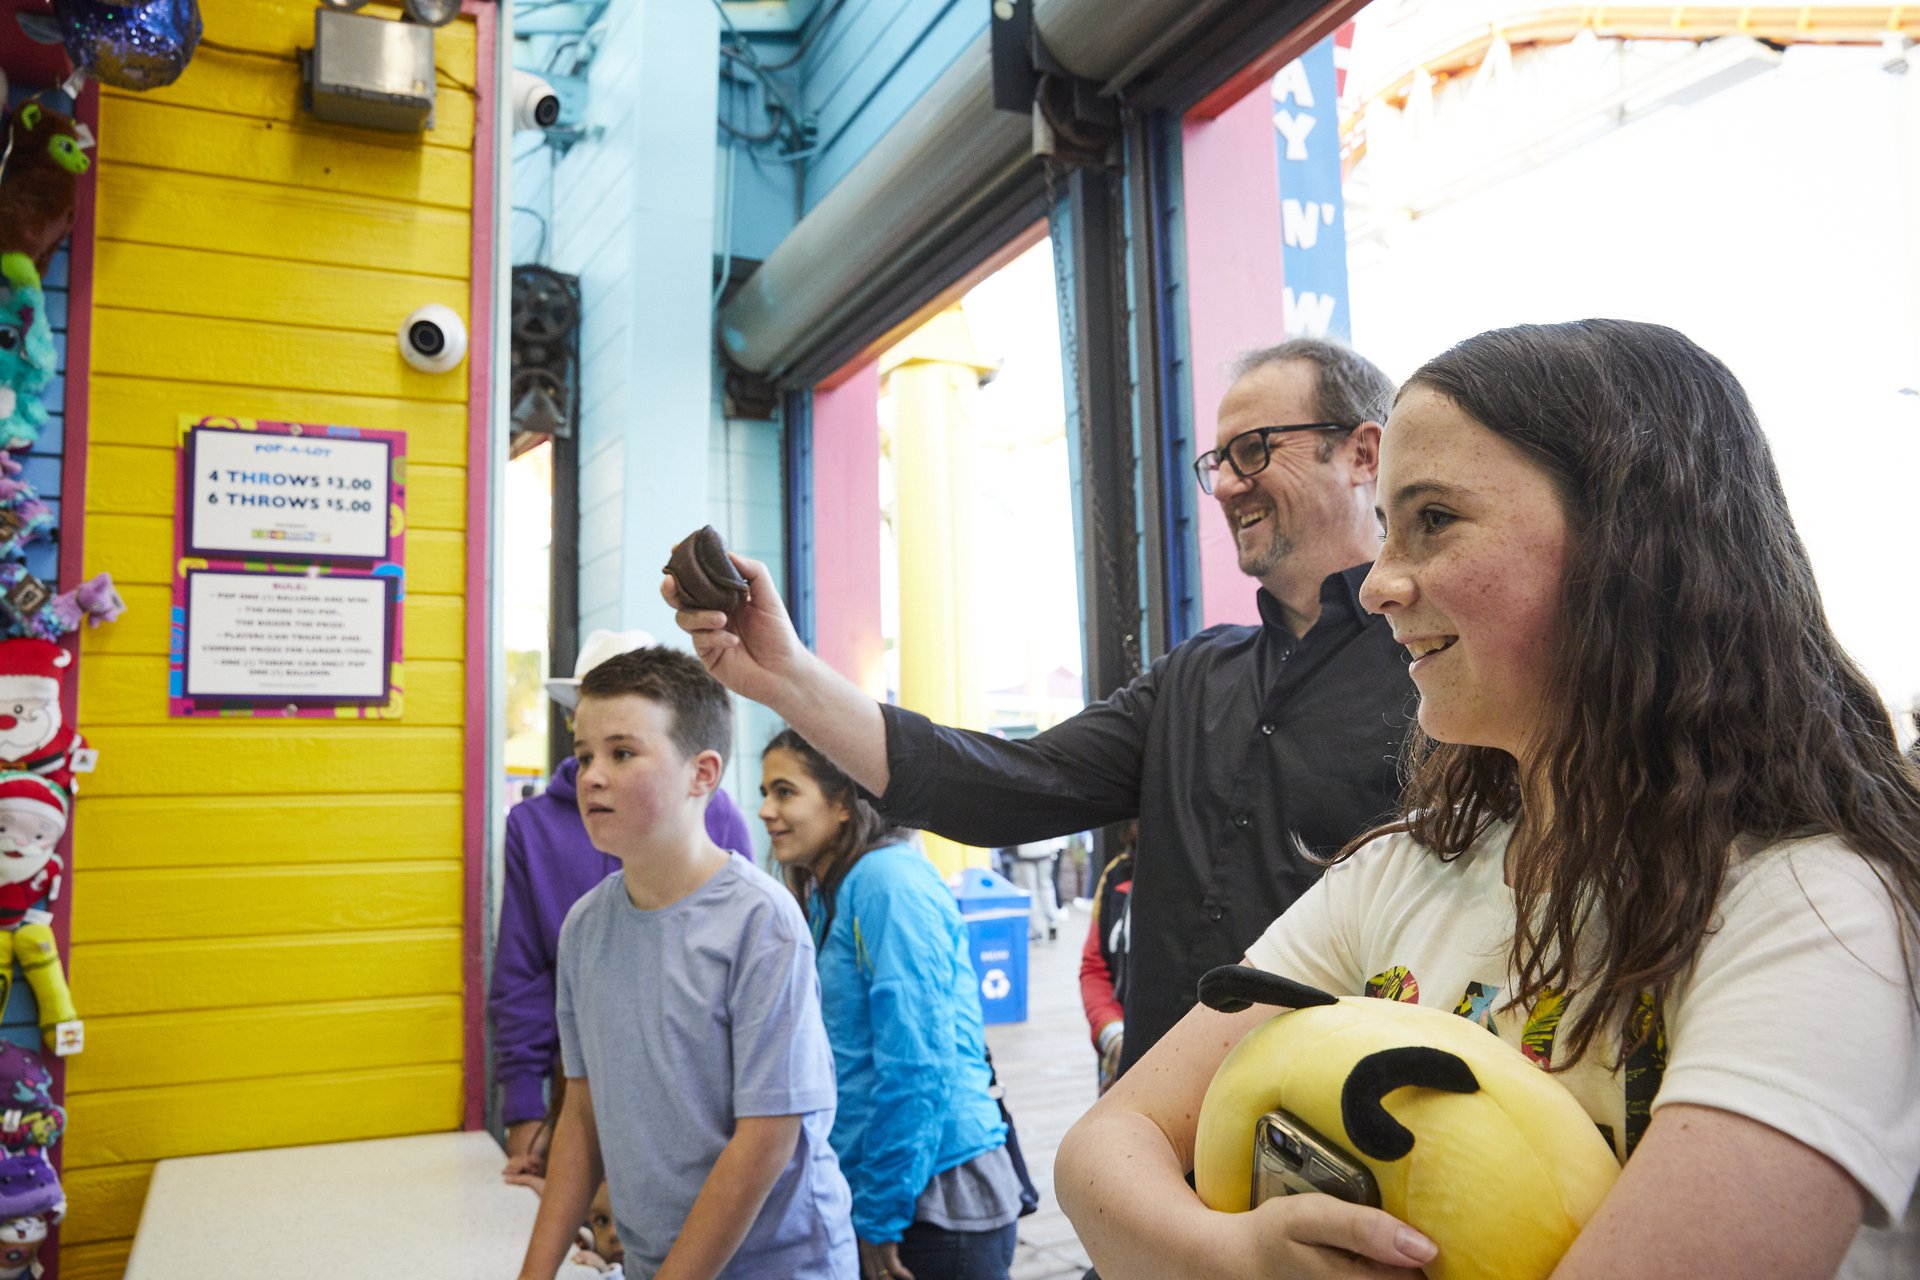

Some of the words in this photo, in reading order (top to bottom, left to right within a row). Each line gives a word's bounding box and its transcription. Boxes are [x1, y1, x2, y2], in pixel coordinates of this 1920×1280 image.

[1282, 198, 1336, 250] N'
[255, 443, 332, 457] POP-A-LOT
[208, 470, 219, 482] 4
[226, 470, 321, 488] THROWS
[327, 476, 373, 491] $3.00
[208, 493, 219, 505] 6
[226, 492, 321, 510] THROWS
[327, 498, 373, 512] $5.00
